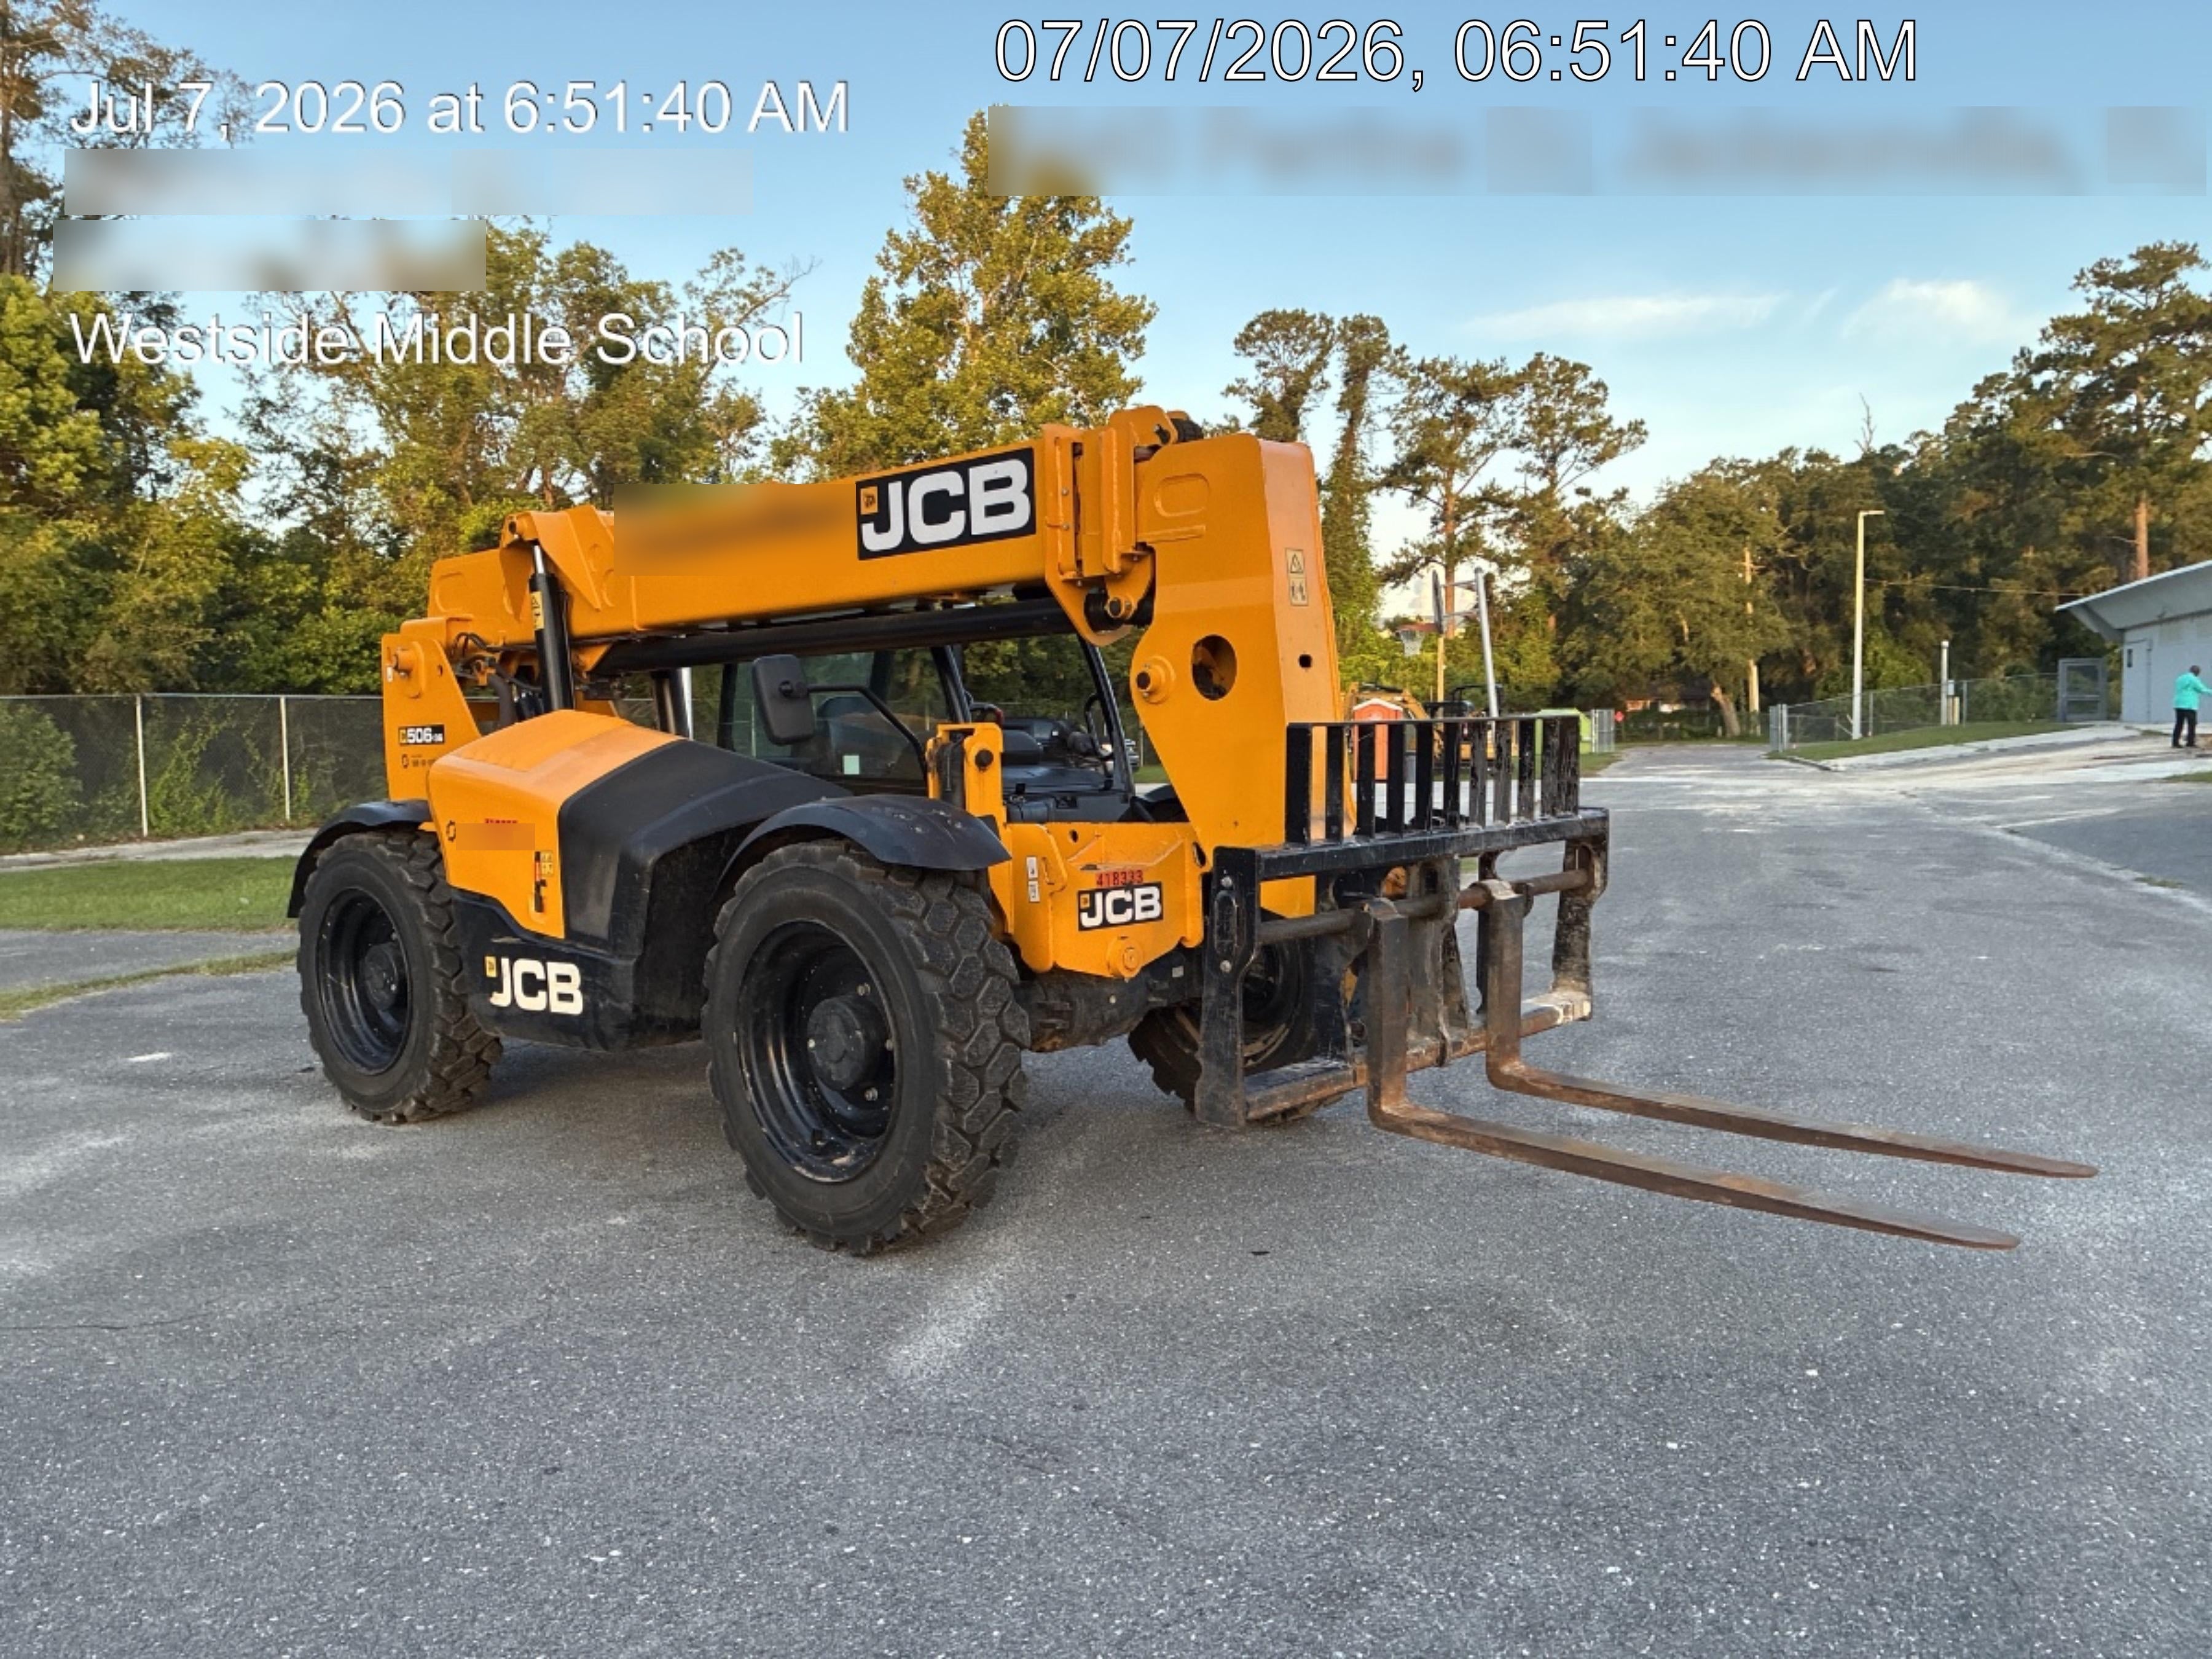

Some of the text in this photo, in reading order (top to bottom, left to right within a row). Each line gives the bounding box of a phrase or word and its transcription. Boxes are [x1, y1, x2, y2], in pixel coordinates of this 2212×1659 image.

[861, 459, 1031, 552] JCB
[1080, 886, 1161, 927] JCB
[490, 957, 583, 1015] JCB
